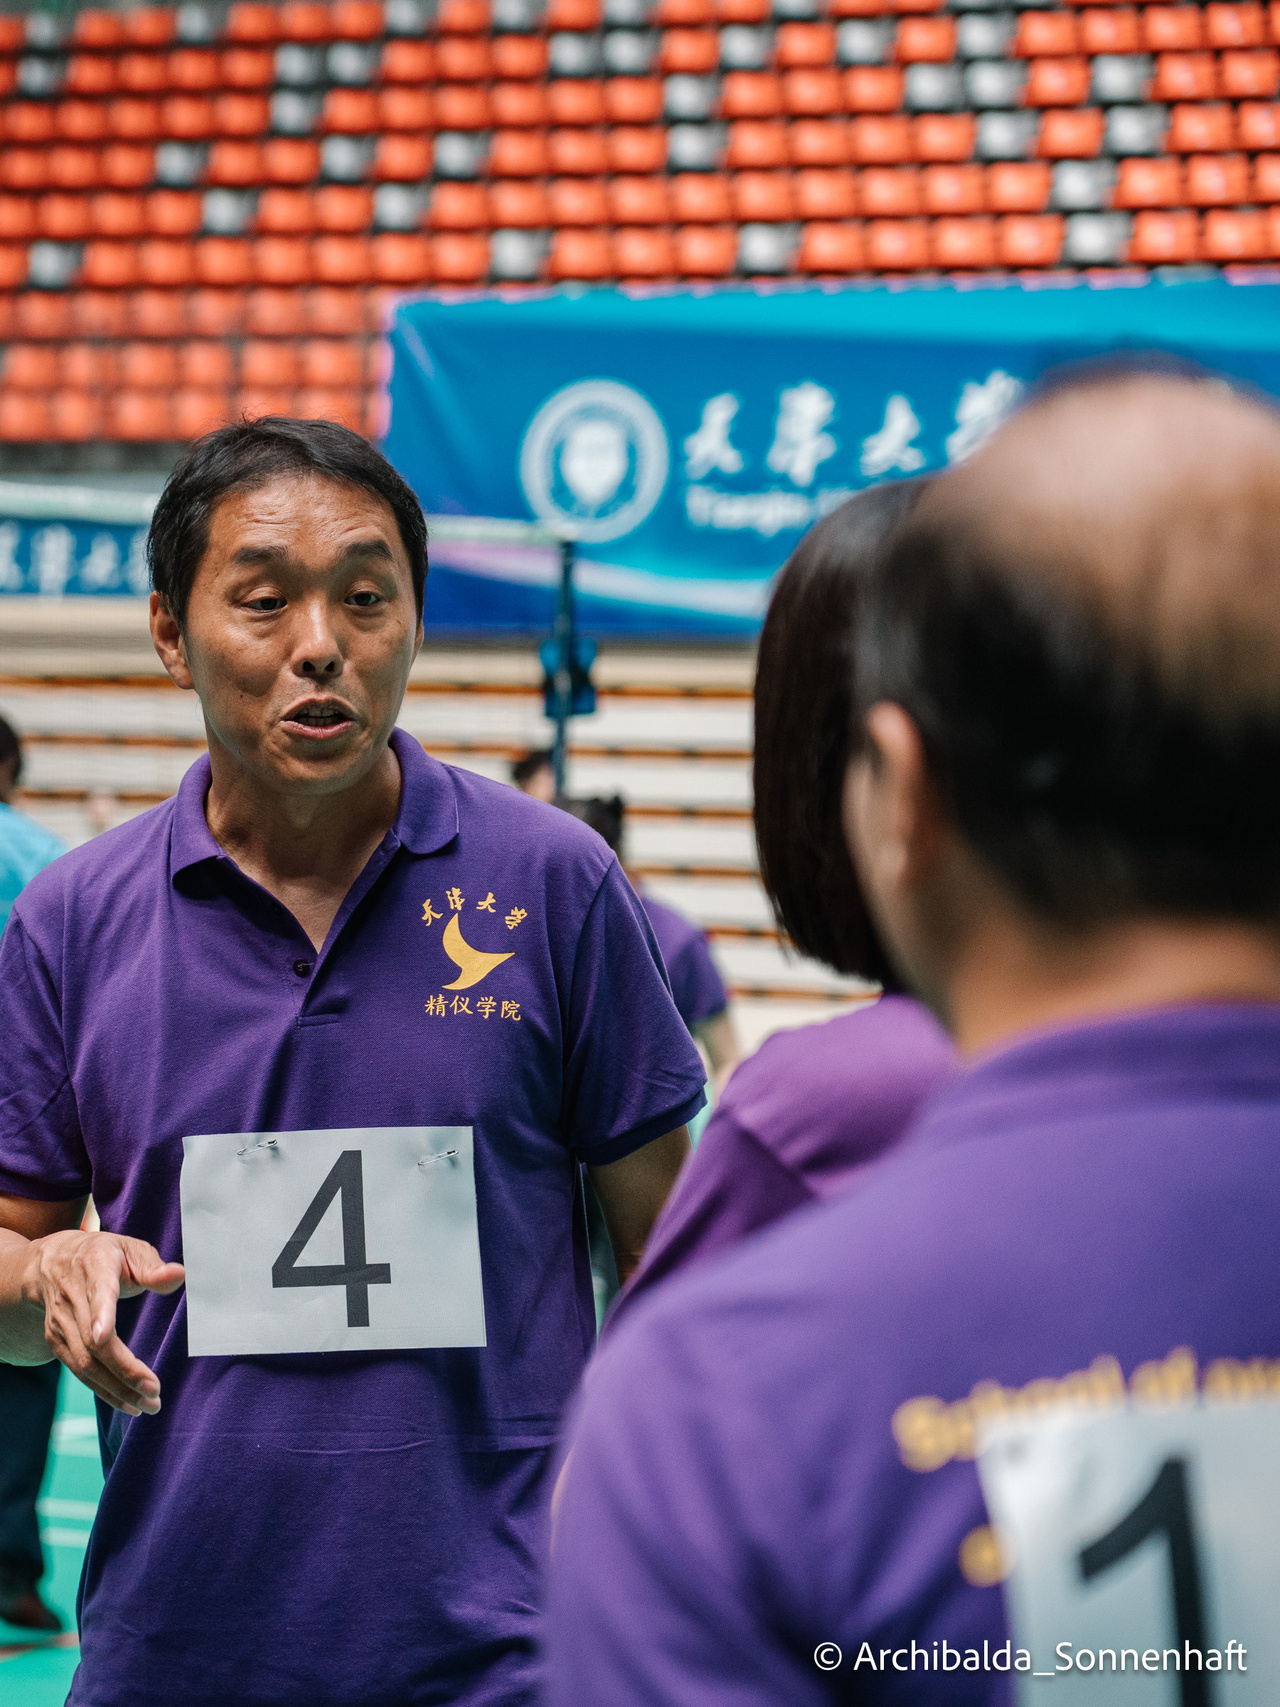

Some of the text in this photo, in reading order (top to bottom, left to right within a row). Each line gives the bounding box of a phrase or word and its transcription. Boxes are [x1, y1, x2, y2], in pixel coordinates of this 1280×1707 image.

[421, 887, 528, 930] 天津大学
[424, 993, 521, 1021] 精仪学院
[272, 1150, 392, 1328] 4
[1079, 1453, 1211, 1707] 1
